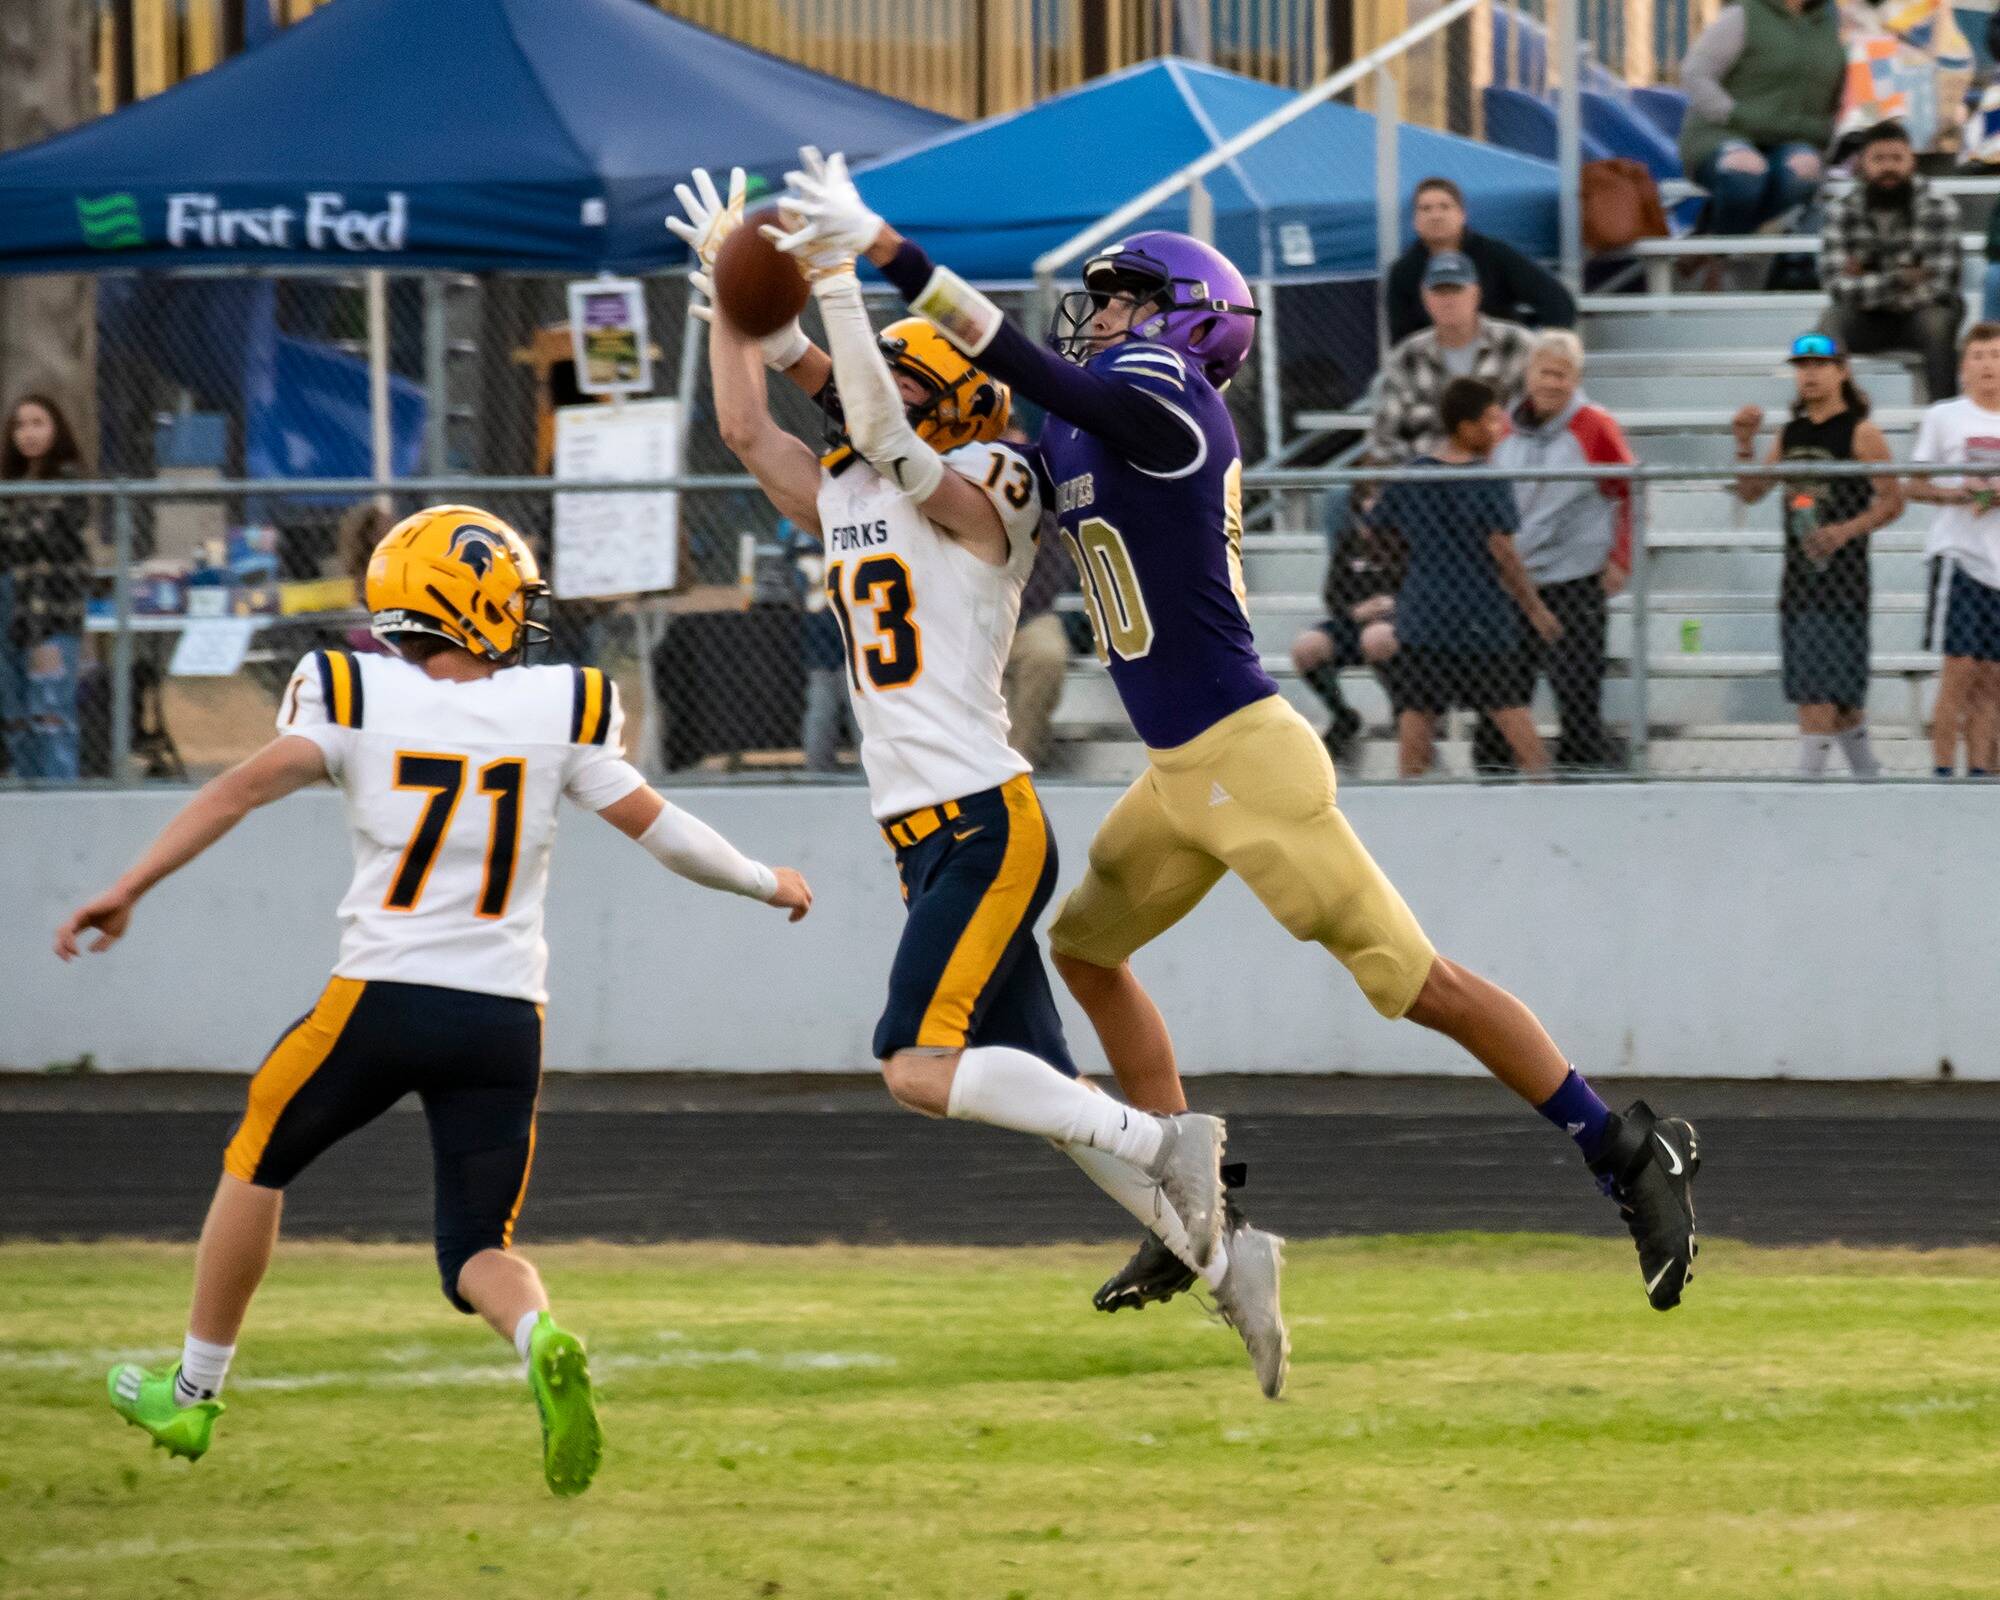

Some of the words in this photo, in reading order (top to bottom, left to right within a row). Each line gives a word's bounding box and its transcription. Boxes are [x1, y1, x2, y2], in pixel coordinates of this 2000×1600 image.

[167, 192, 294, 247] First
[306, 190, 408, 251] Fed
[983, 450, 1034, 511] 13
[831, 519, 888, 551] FORKS
[826, 553, 923, 694] 13
[382, 750, 527, 920] 71
